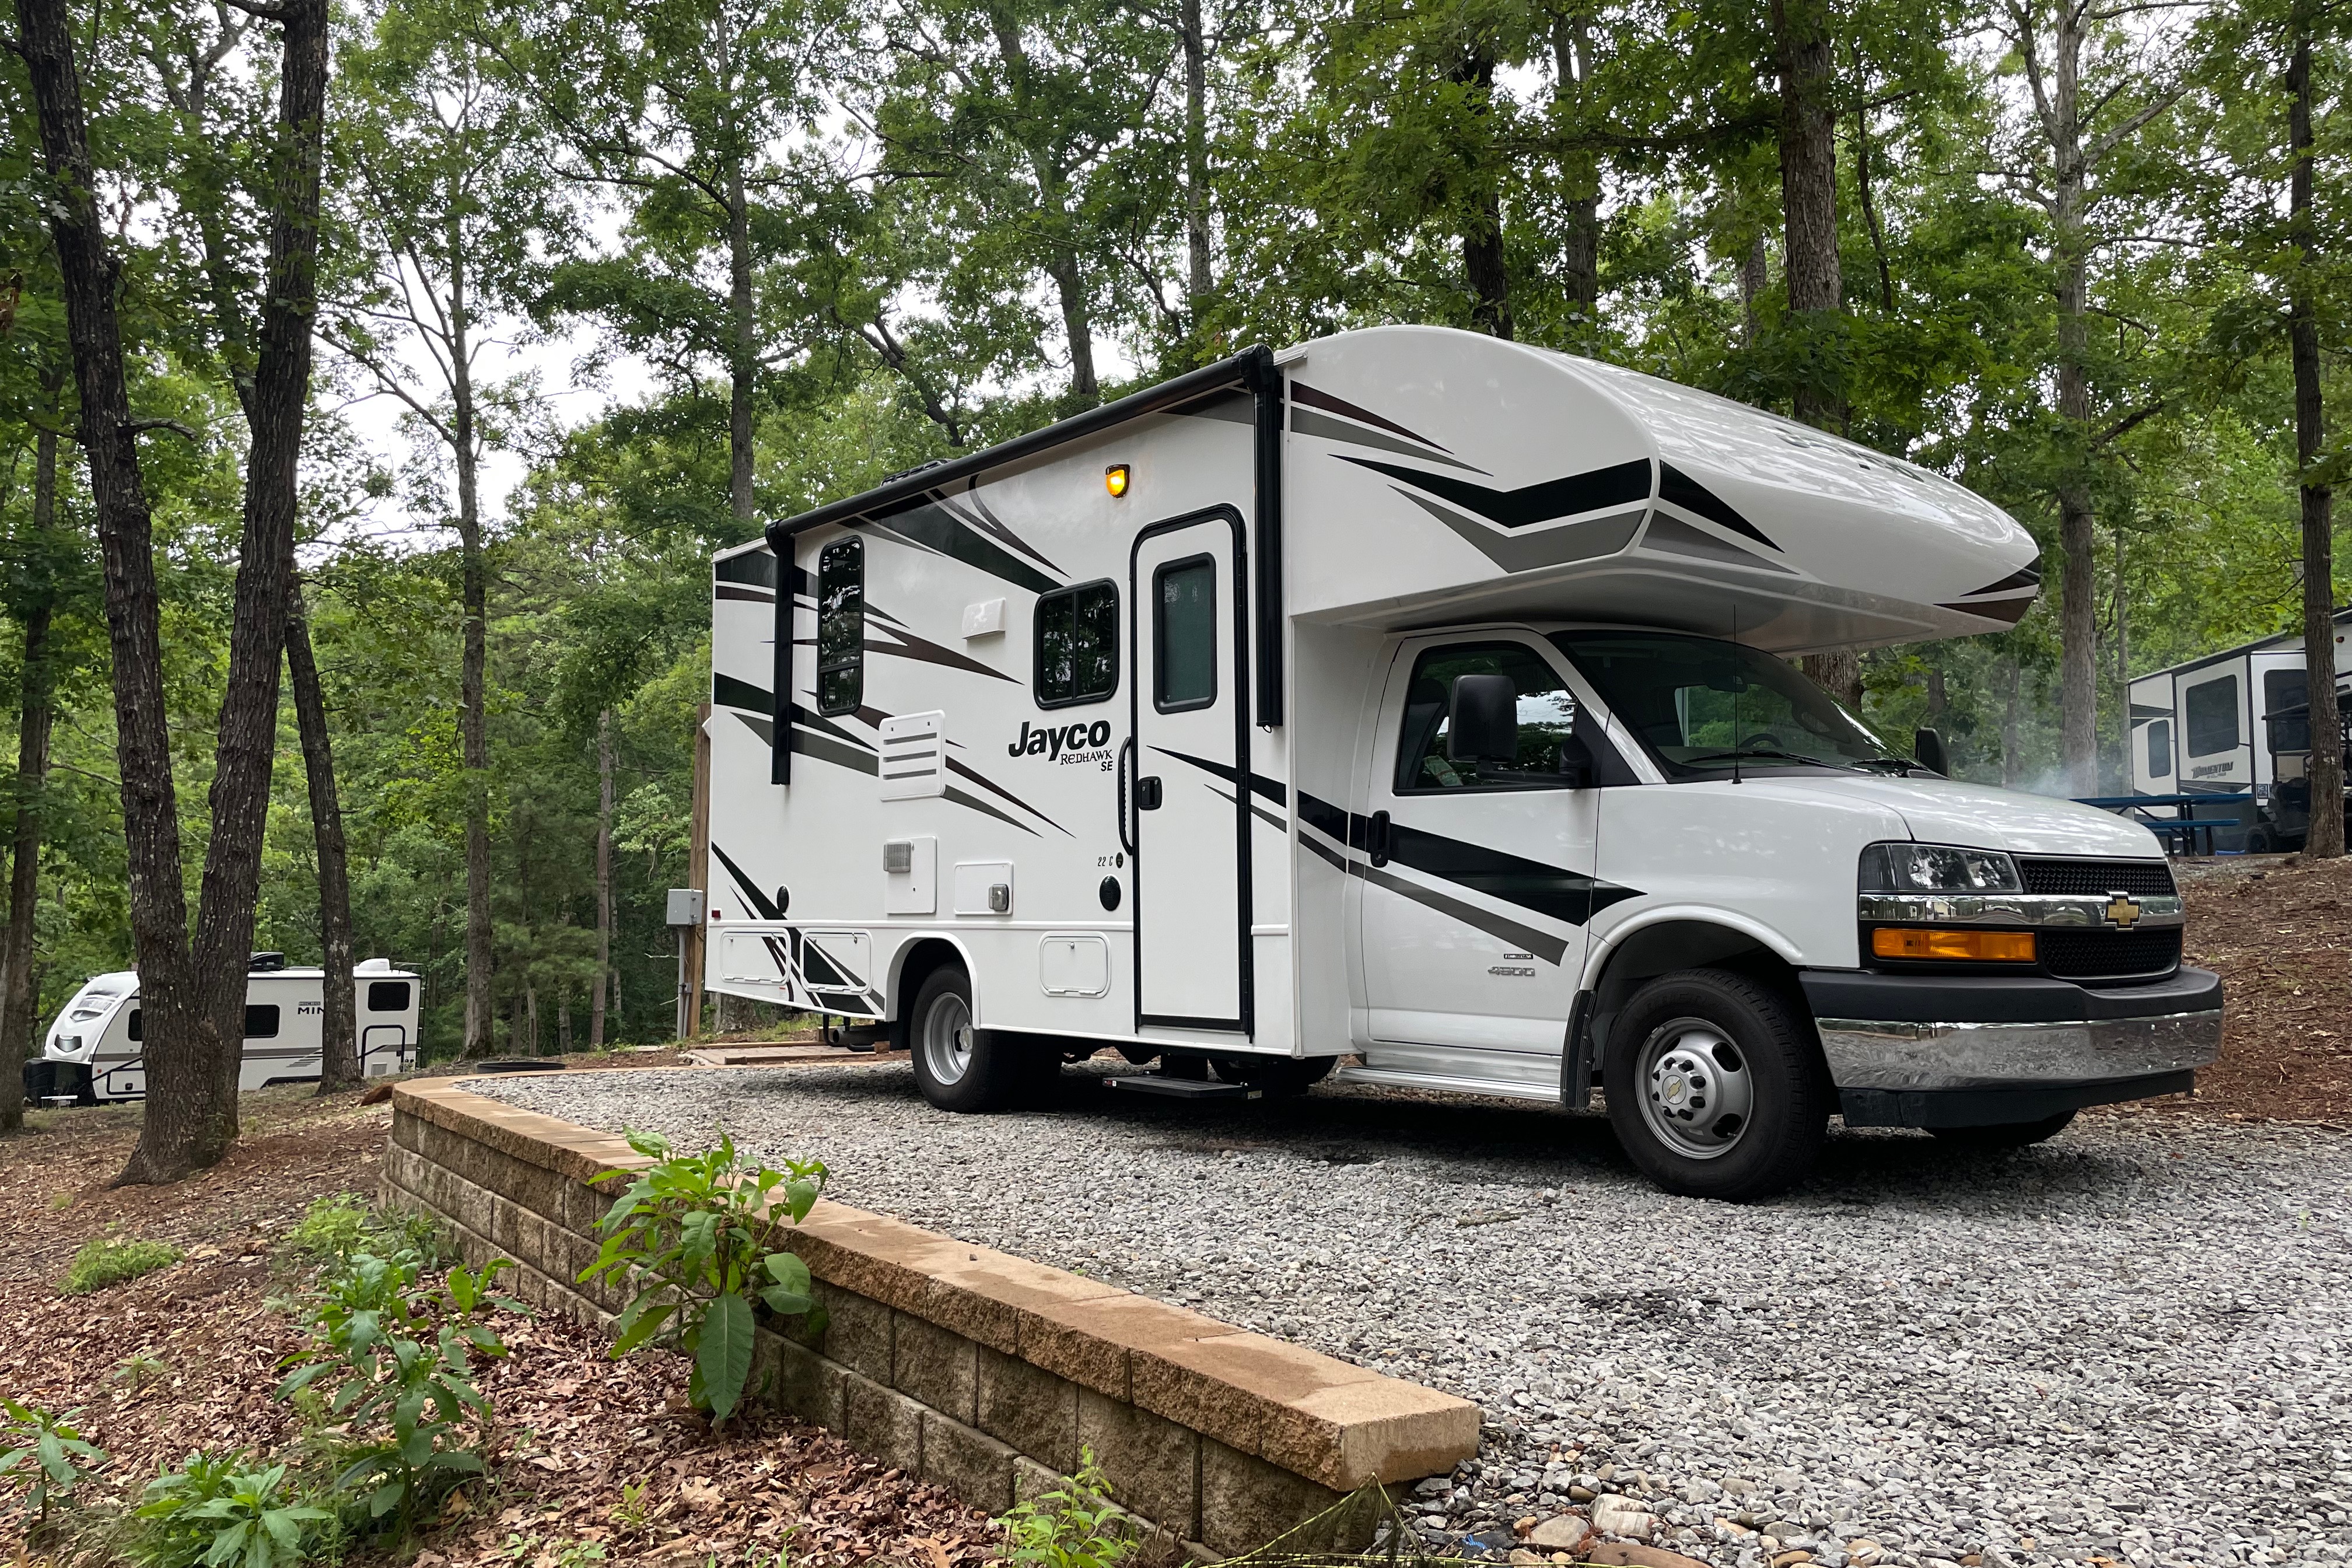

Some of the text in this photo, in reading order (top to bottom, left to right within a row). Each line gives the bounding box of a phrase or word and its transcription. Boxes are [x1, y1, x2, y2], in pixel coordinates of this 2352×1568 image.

[1009, 720, 1111, 761] Jayco
[1101, 761, 1113, 772] SE
[1097, 856, 1114, 867] 22 C
[1488, 966, 1535, 977] 4500
